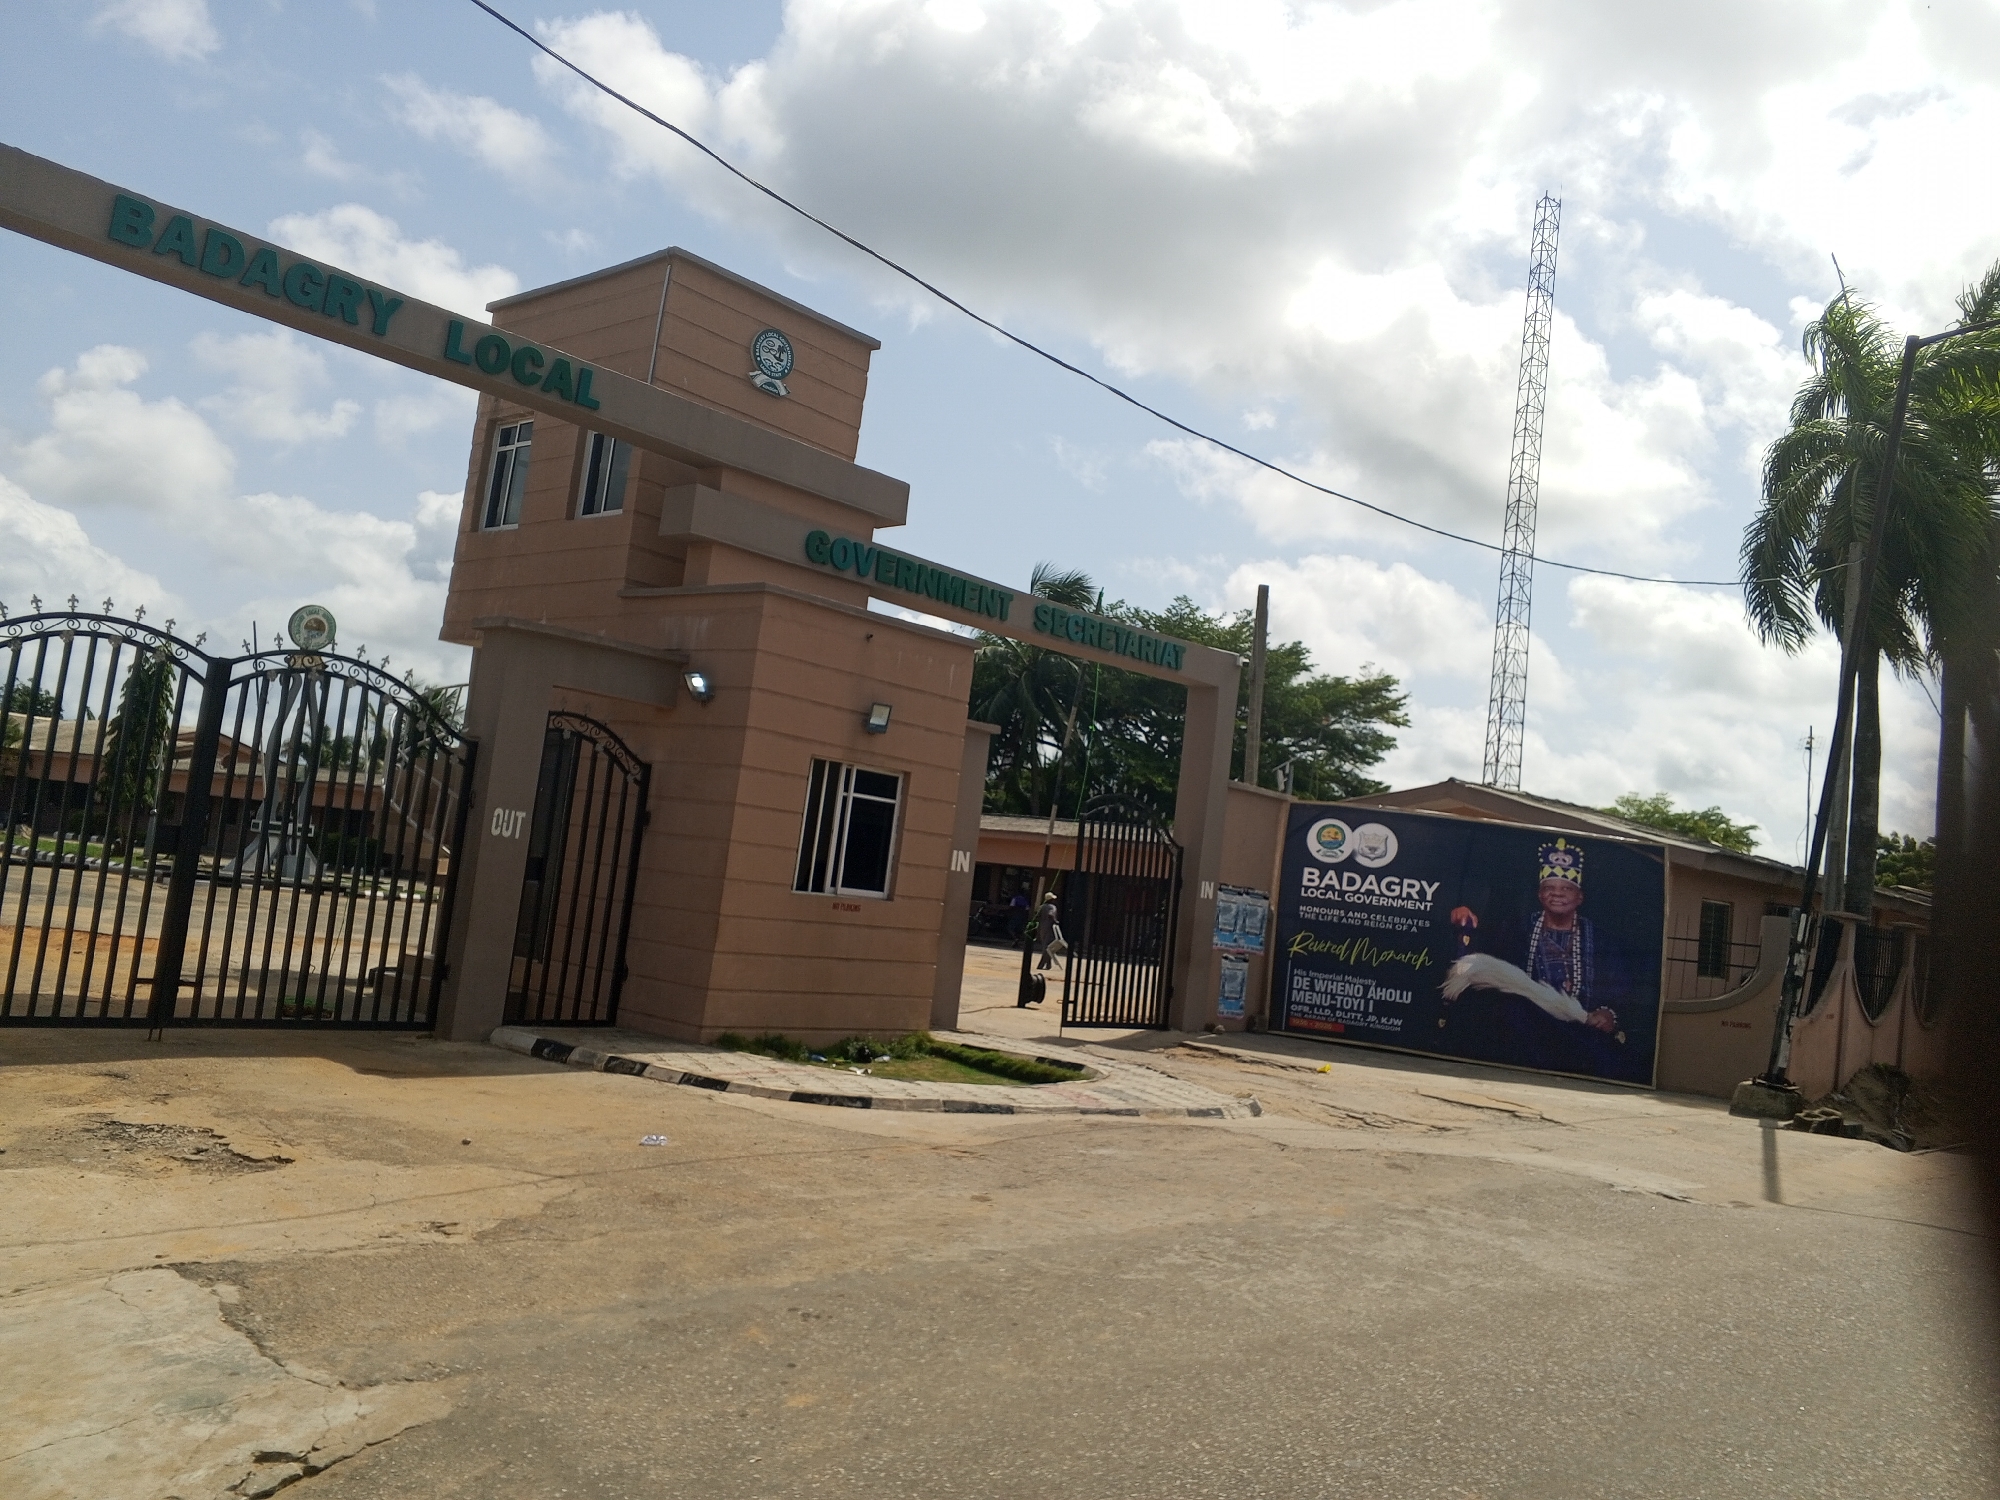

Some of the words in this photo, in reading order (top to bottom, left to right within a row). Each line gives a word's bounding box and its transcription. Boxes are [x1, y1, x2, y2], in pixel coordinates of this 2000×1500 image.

[108, 193, 403, 336] BADAGRY
[444, 319, 600, 410] LOCAL
[805, 529, 1014, 622] GOVERNMENT
[1033, 604, 1187, 671] SECRETARIAT
[491, 807, 526, 839] OUT
[951, 850, 971, 872] IN
[1200, 881, 1214, 900] IN
[1302, 867, 1440, 901] BADAGRY
[1300, 887, 1342, 901] LOCAL
[1344, 892, 1434, 912] GOVERNMENT
[1299, 905, 1345, 917] HONOURS
[1347, 910, 1368, 920] AND
[1370, 913, 1431, 928] CELEBRATES
[1299, 912, 1317, 920] THE
[1318, 914, 1339, 923] LIFE
[1341, 917, 1361, 926] AND
[1363, 919, 1393, 930] REIGN
[1395, 923, 1408, 931] OF
[1410, 925, 1418, 933] A
[1287, 930, 1350, 961] Revered
[1350, 937, 1433, 970] Monarch
[1294, 968, 1308, 977] His
[1309, 970, 1343, 982] Imperial
[1344, 974, 1377, 986] Majesty
[1291, 989, 1365, 1012] MENU-TOYI
[1368, 1000, 1374, 1013] I
[1293, 976, 1311, 990] DE
[1314, 978, 1364, 997] WHENO
[1367, 985, 1412, 1004] AHOLU
[1313, 1007, 1334, 1017] LLD,
